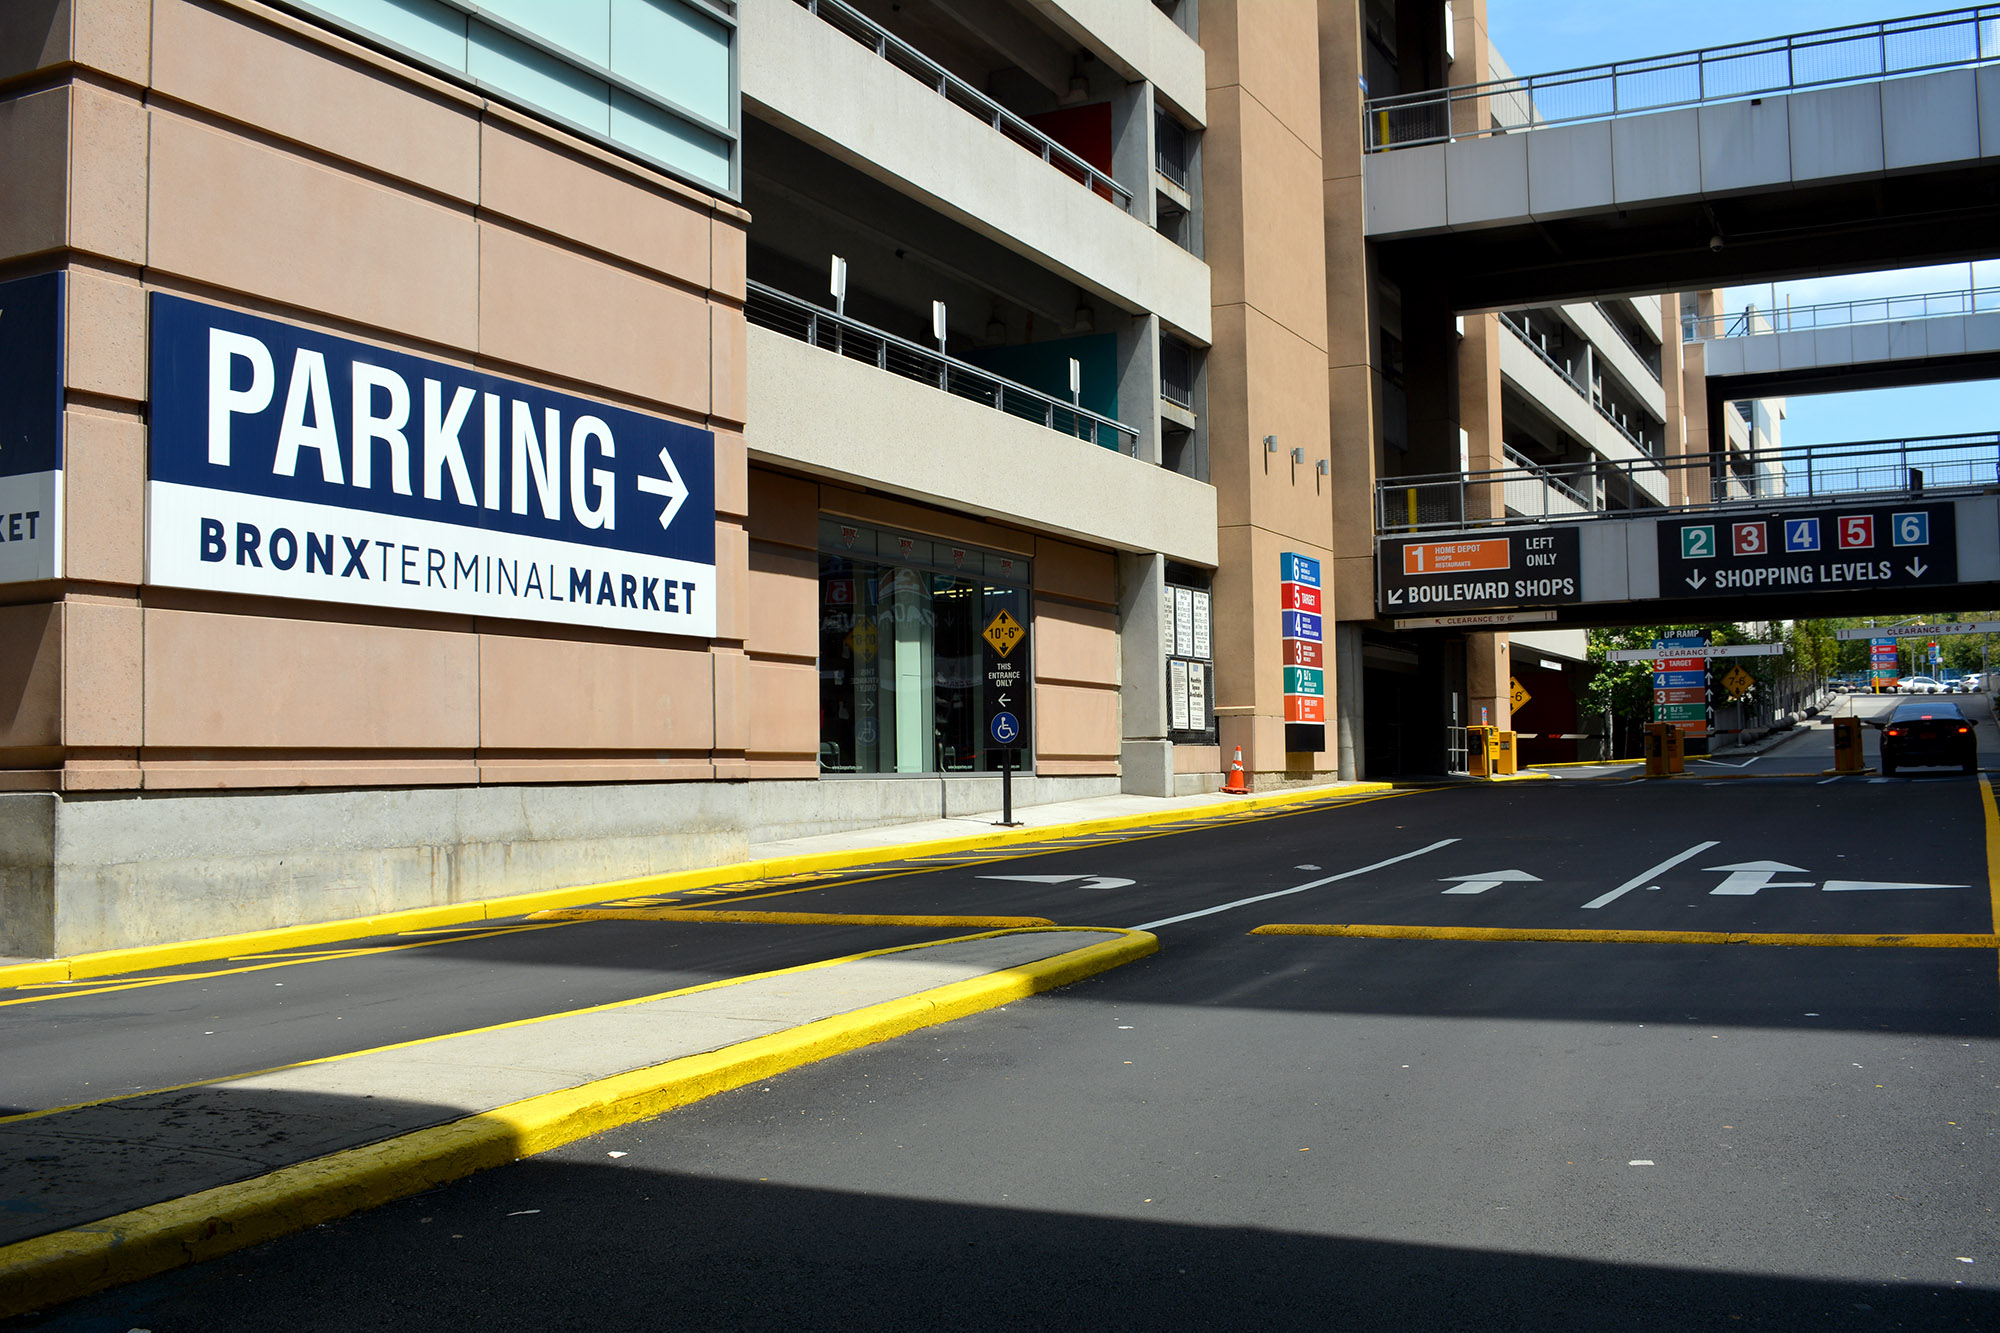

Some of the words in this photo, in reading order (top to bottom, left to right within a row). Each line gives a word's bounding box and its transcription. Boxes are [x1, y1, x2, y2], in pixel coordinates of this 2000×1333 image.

[208, 327, 617, 531] PARKING
[1688, 529, 1708, 555] 2
[1740, 526, 1760, 552] 3
[1792, 522, 1813, 548] 4
[1846, 518, 1867, 545] 5
[1900, 516, 1921, 542] 6
[1525, 536, 1554, 550] LEFT
[1412, 546, 1424, 572] 1
[1435, 546, 1456, 555] HOME
[1457, 544, 1480, 553] DEPOT
[1435, 561, 1471, 569] RESTAURANTS
[1526, 553, 1557, 567] ONLY
[1293, 557, 1300, 580] 6
[1715, 565, 1813, 589] SHOPPING
[1820, 560, 1892, 583] LEVELS
[1294, 585, 1301, 608] 5
[1408, 581, 1509, 604] BOULEVARD
[1514, 577, 1575, 598] SHOPS
[1295, 613, 1301, 637] 4
[1447, 615, 1493, 625] CLEARANCE
[988, 627, 1019, 639] 10'-6"
[1664, 631, 1675, 639] UP
[1677, 630, 1699, 638] RAMP
[1887, 626, 1941, 636] CLEARANCE
[1295, 641, 1302, 664] 3
[1658, 649, 1709, 658] CLEARANCE
[997, 663, 1012, 671] THIS
[1656, 659, 1665, 670] 5
[988, 671, 1020, 680] ENTRANCE
[1296, 669, 1303, 692] 2
[1657, 674, 1666, 686] 4
[996, 679, 1013, 687] ONLY
[1657, 691, 1666, 703] 3
[1297, 697, 1302, 720] 1
